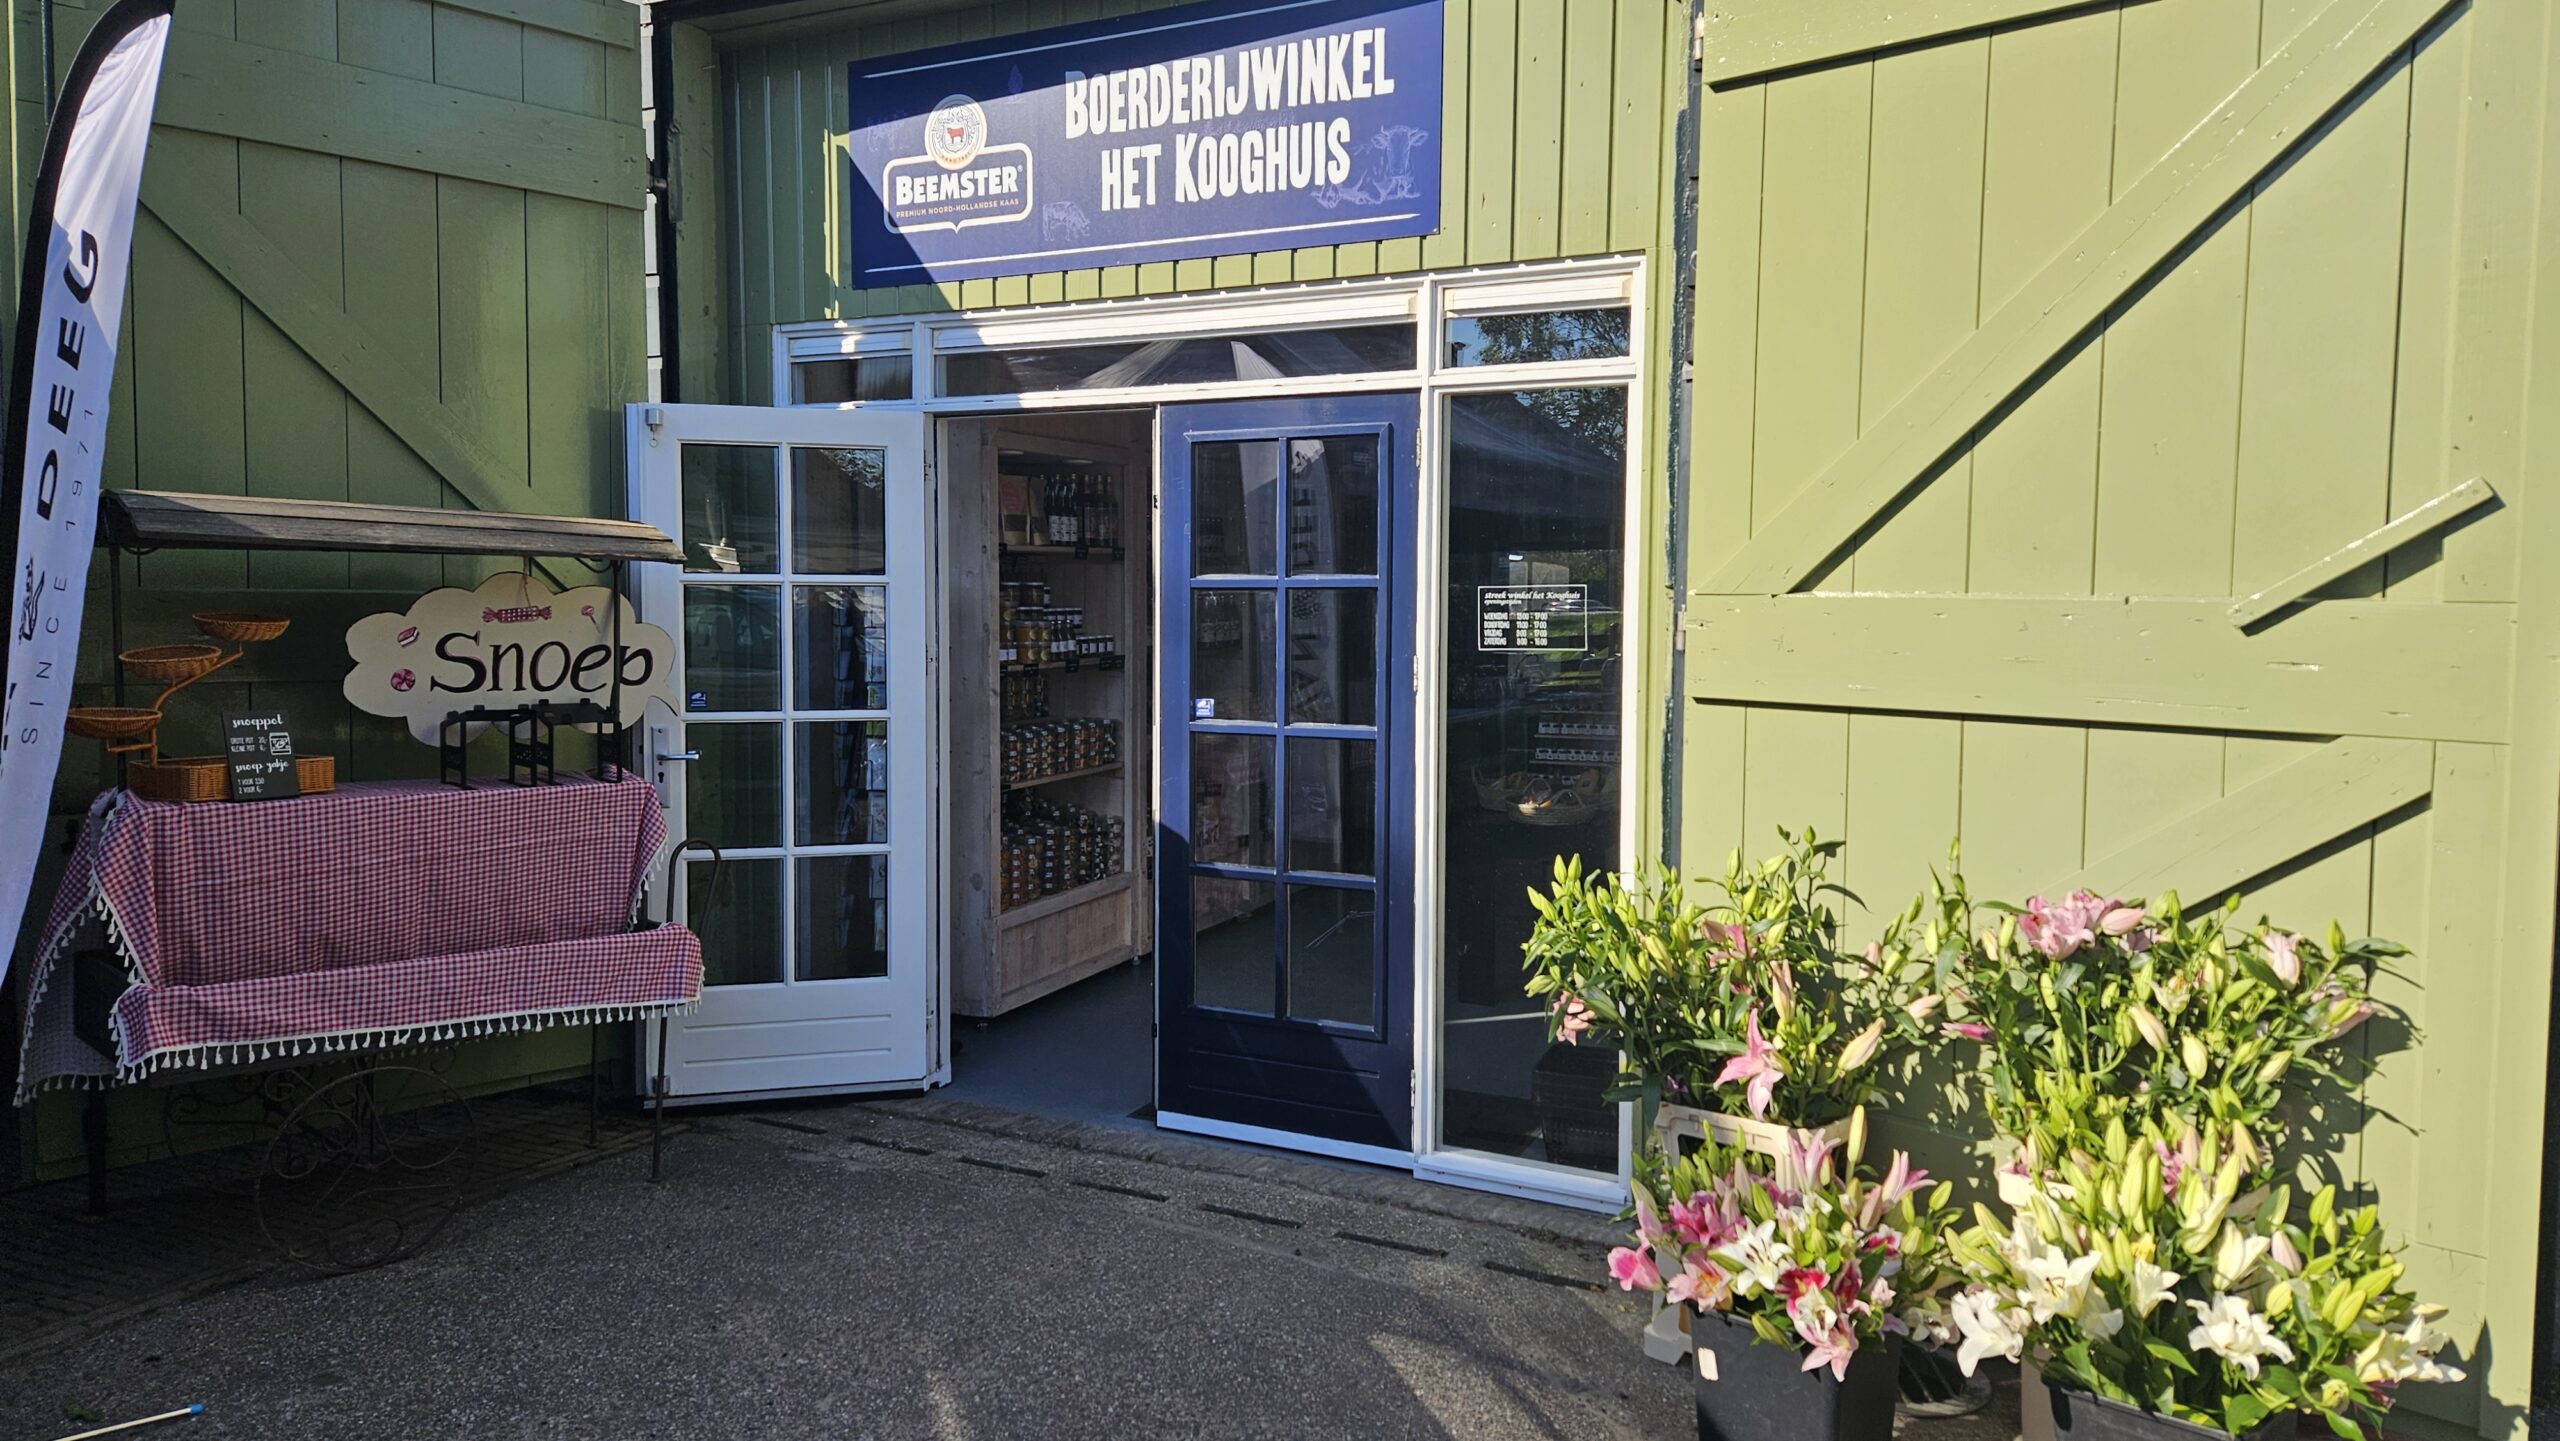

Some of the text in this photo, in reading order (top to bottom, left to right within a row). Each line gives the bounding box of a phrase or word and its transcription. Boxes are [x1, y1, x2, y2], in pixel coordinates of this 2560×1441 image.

[1065, 28, 1394, 139] BOERDERIJWINKEL
[1101, 117, 1350, 212] HET KOOGHUIS
[896, 198, 1019, 219] PREMIUM NOORD-HOLLANDSE KAAS
[37, 228, 99, 520] DEEG
[22, 408, 94, 744] SINCE 1971
[1484, 591, 1580, 601] streek winkel het Kooghuis
[430, 630, 653, 706] Snoep
[232, 713, 284, 731] snoeppot
[235, 763, 263, 774] snoep
